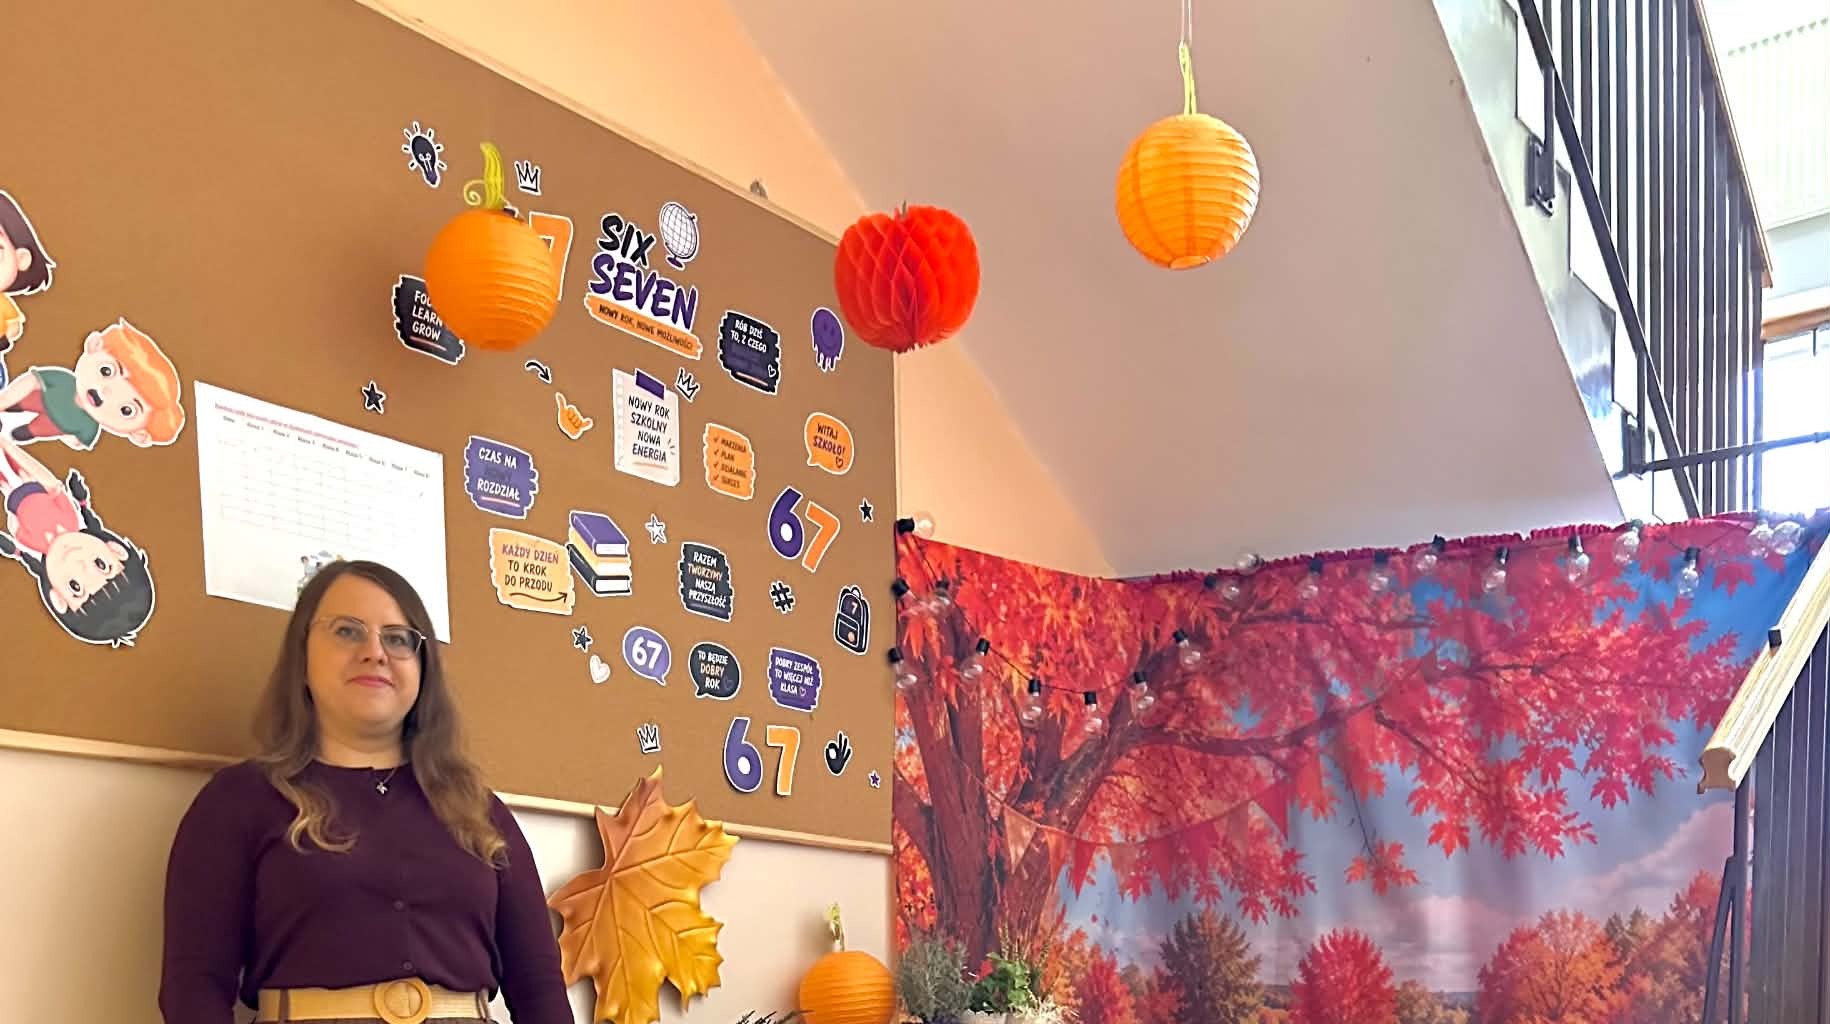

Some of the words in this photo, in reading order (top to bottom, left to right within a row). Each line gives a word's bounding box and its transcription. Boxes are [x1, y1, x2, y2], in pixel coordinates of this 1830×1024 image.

[599, 215, 655, 266] SIX
[590, 254, 697, 330] SEVEN
[412, 305, 443, 328] LEARN
[599, 304, 619, 319] NOWY
[636, 320, 655, 335] NOWE
[412, 321, 441, 341] GROW
[735, 319, 748, 333] RÓB
[749, 325, 764, 339] DZIŚ
[730, 330, 740, 343] TO,
[741, 334, 747, 345] Z
[747, 337, 767, 353] CZEGO
[628, 395, 652, 412] NOWY
[654, 404, 670, 419] ROK
[630, 411, 667, 434] SZKOLNY
[817, 423, 839, 440] WITAJ
[637, 430, 661, 447] NOWA
[478, 447, 502, 464] CZAS
[504, 455, 517, 469] NA
[632, 443, 667, 462] ENERGIA
[477, 478, 520, 501] ROZDZIAŁ
[768, 486, 840, 573] 67
[502, 543, 531, 559] KAŻDY
[693, 551, 718, 568] RAZEM
[508, 559, 520, 572] TO
[523, 561, 547, 577] KROK
[688, 563, 723, 581] TWORZYMY
[504, 574, 517, 587] DO
[519, 576, 553, 592] PRZODU
[695, 579, 716, 595] NASZĄ
[688, 589, 727, 609] PRZYSZŁOŚĆ
[632, 636, 663, 670] 67
[698, 650, 707, 660] TO
[707, 651, 729, 666] BĘDZIE
[775, 656, 793, 669] DOBRY
[700, 663, 725, 678] DOBRY
[775, 668, 783, 679] TO
[704, 678, 720, 690] ROK
[780, 682, 798, 695] KLASA
[724, 717, 800, 795] 67
